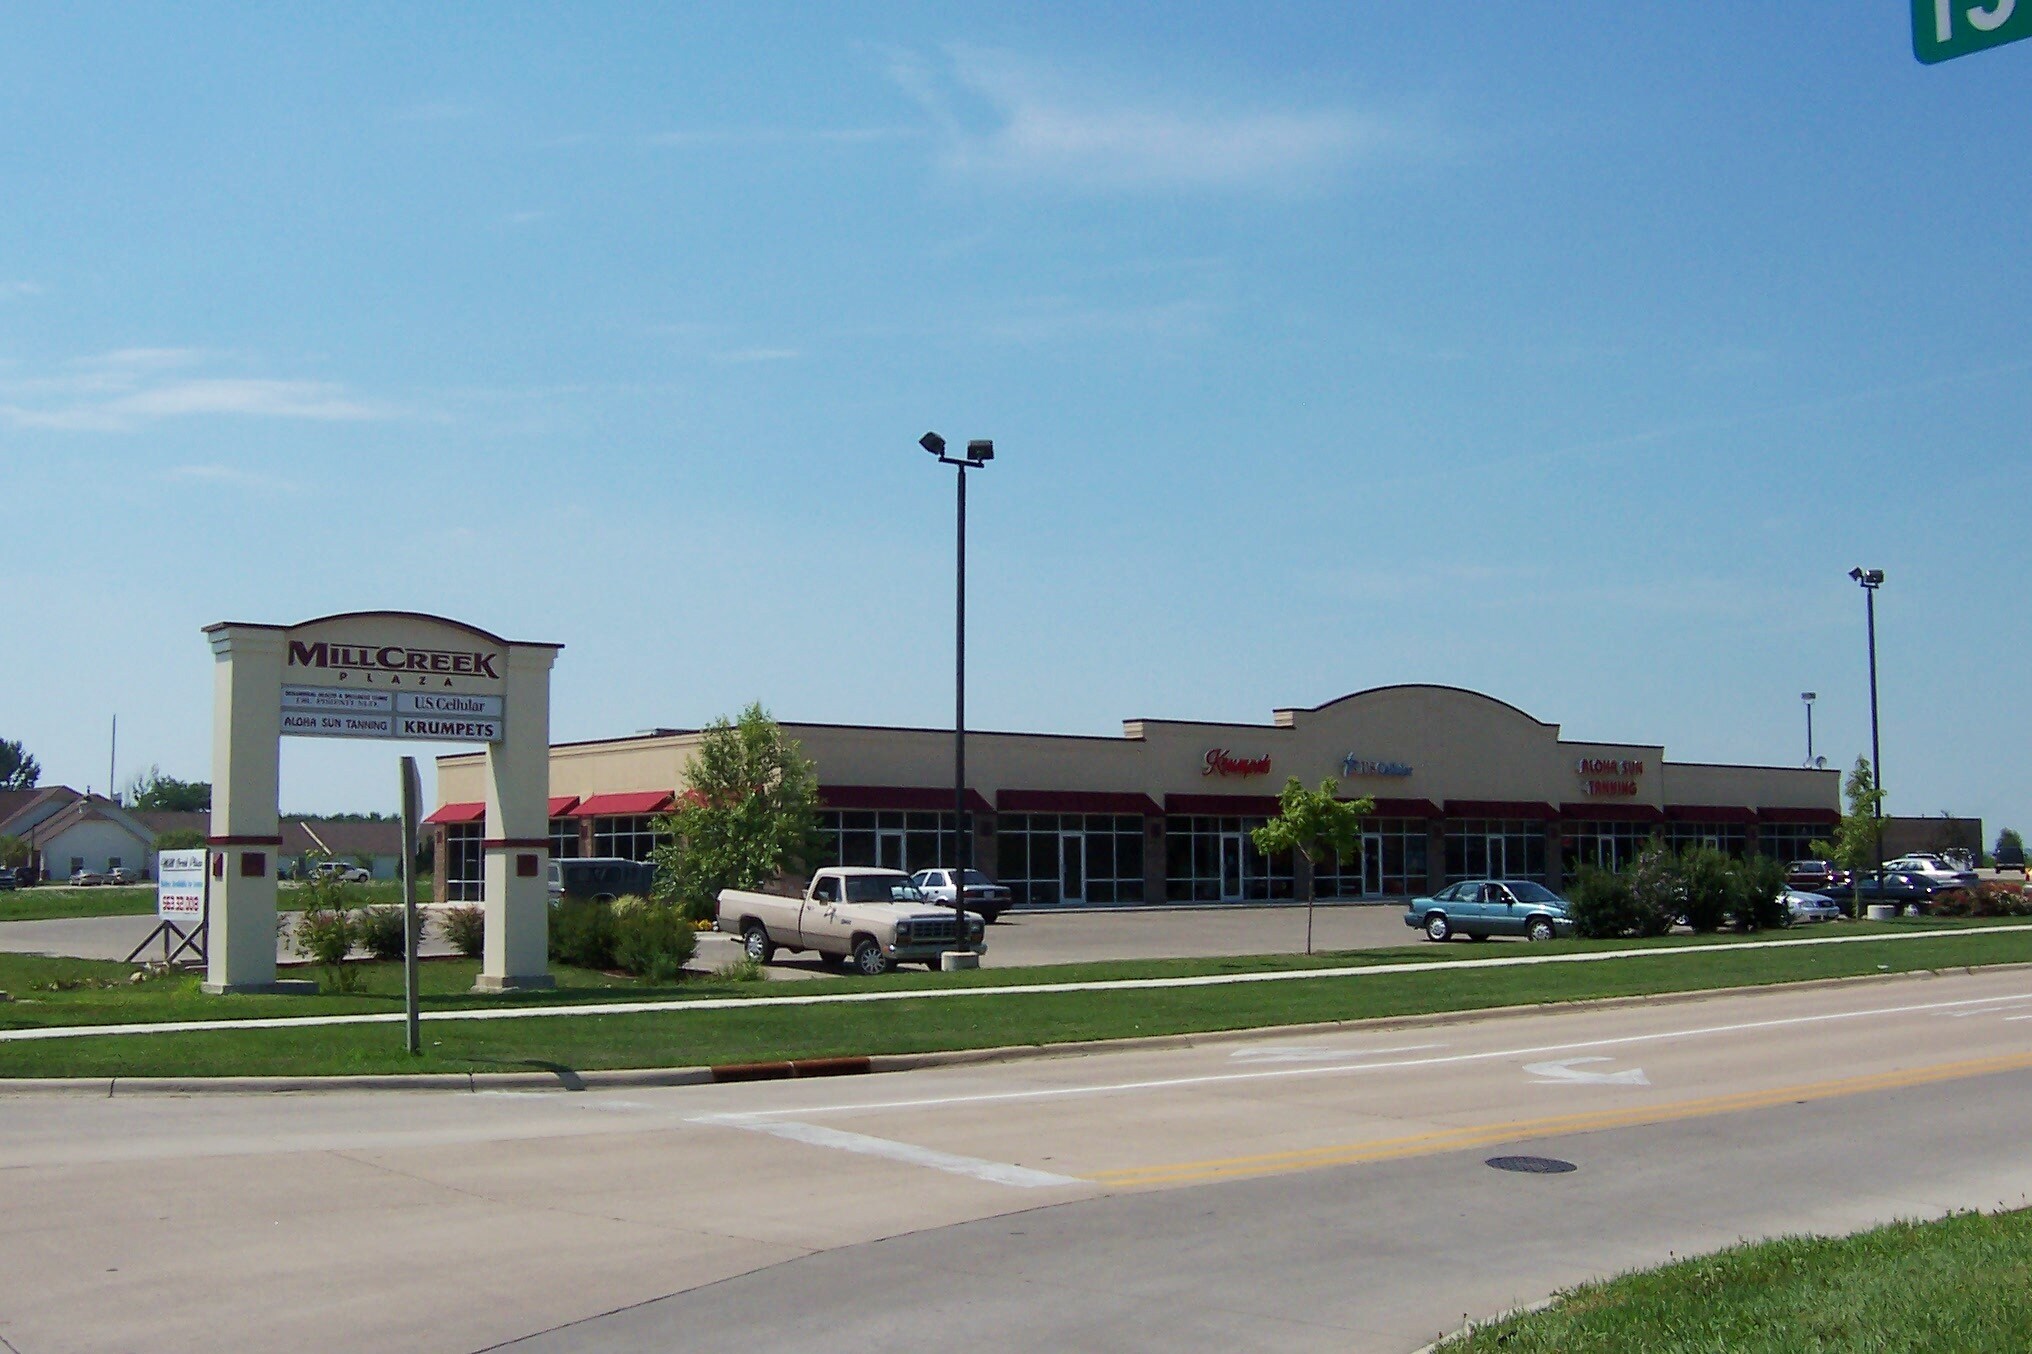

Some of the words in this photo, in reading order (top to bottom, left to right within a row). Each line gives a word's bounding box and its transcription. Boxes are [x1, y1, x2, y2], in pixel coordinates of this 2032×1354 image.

[339, 672, 453, 687] PLAZA
[436, 698, 486, 713] Cellular
[284, 717, 317, 727] ALOHA
[321, 718, 342, 729] SUN
[345, 719, 388, 731] TANNING
[404, 720, 494, 737] KRUMPETS
